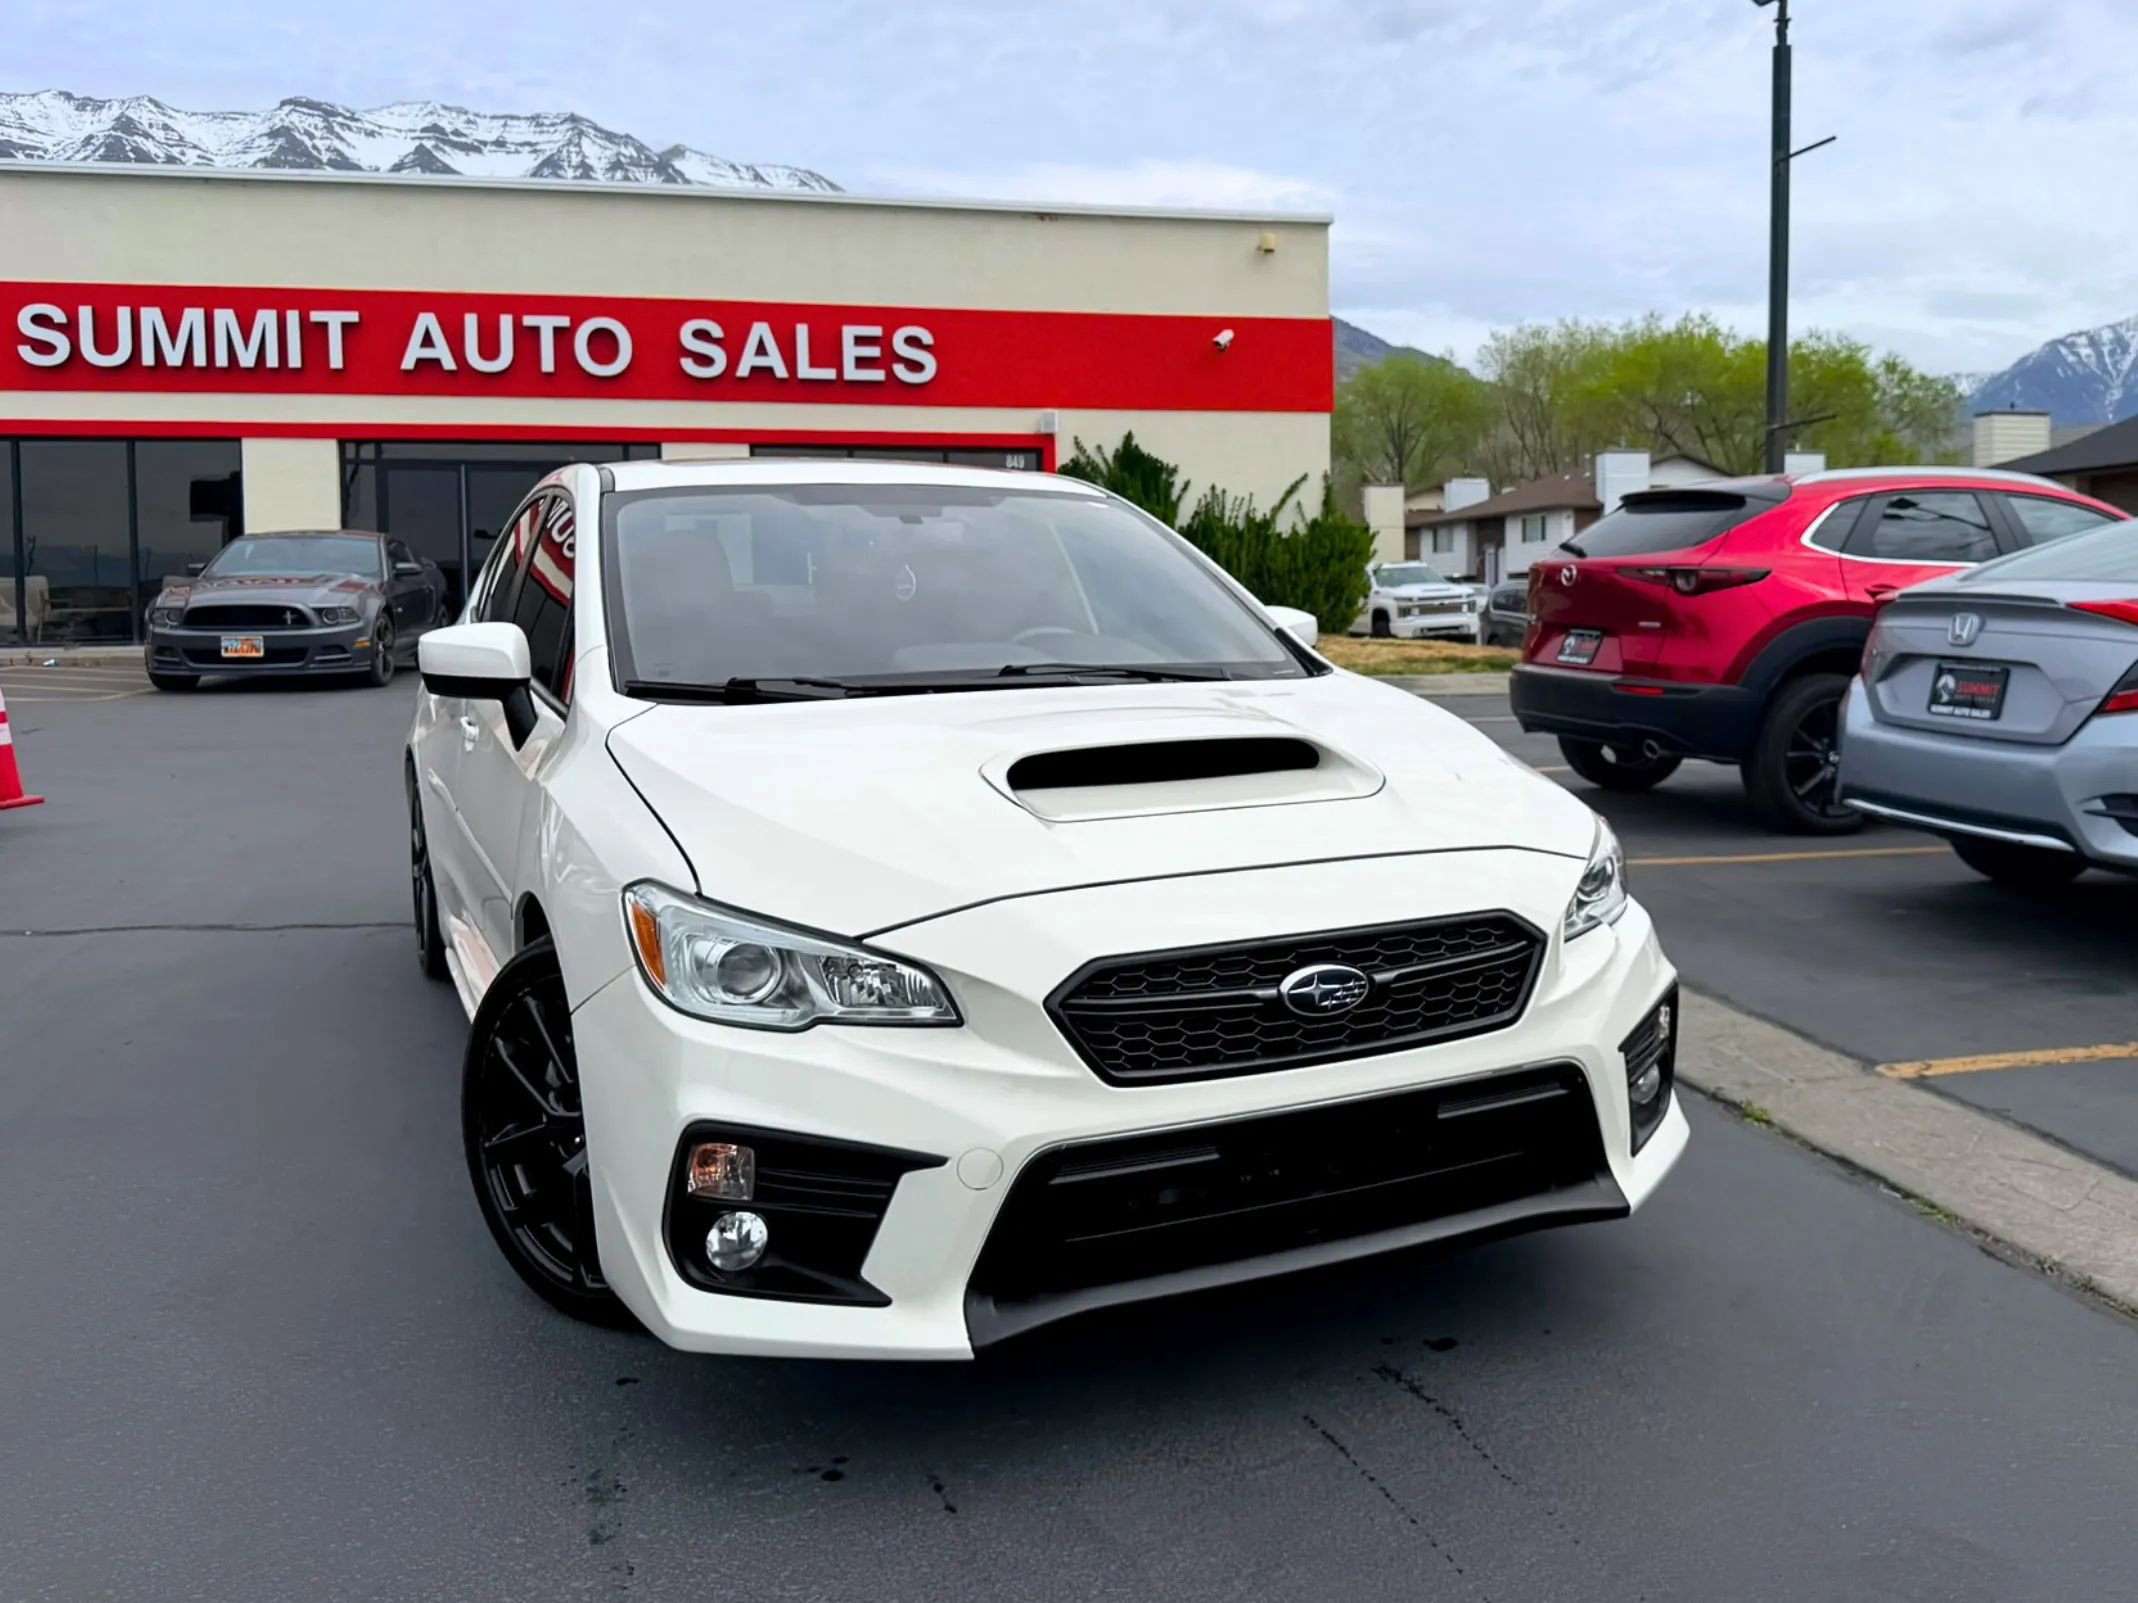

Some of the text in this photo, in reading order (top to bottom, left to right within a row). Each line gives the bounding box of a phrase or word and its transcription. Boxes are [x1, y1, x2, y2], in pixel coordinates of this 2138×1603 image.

[17, 303, 937, 384] SUMMIT AUTO SALES
